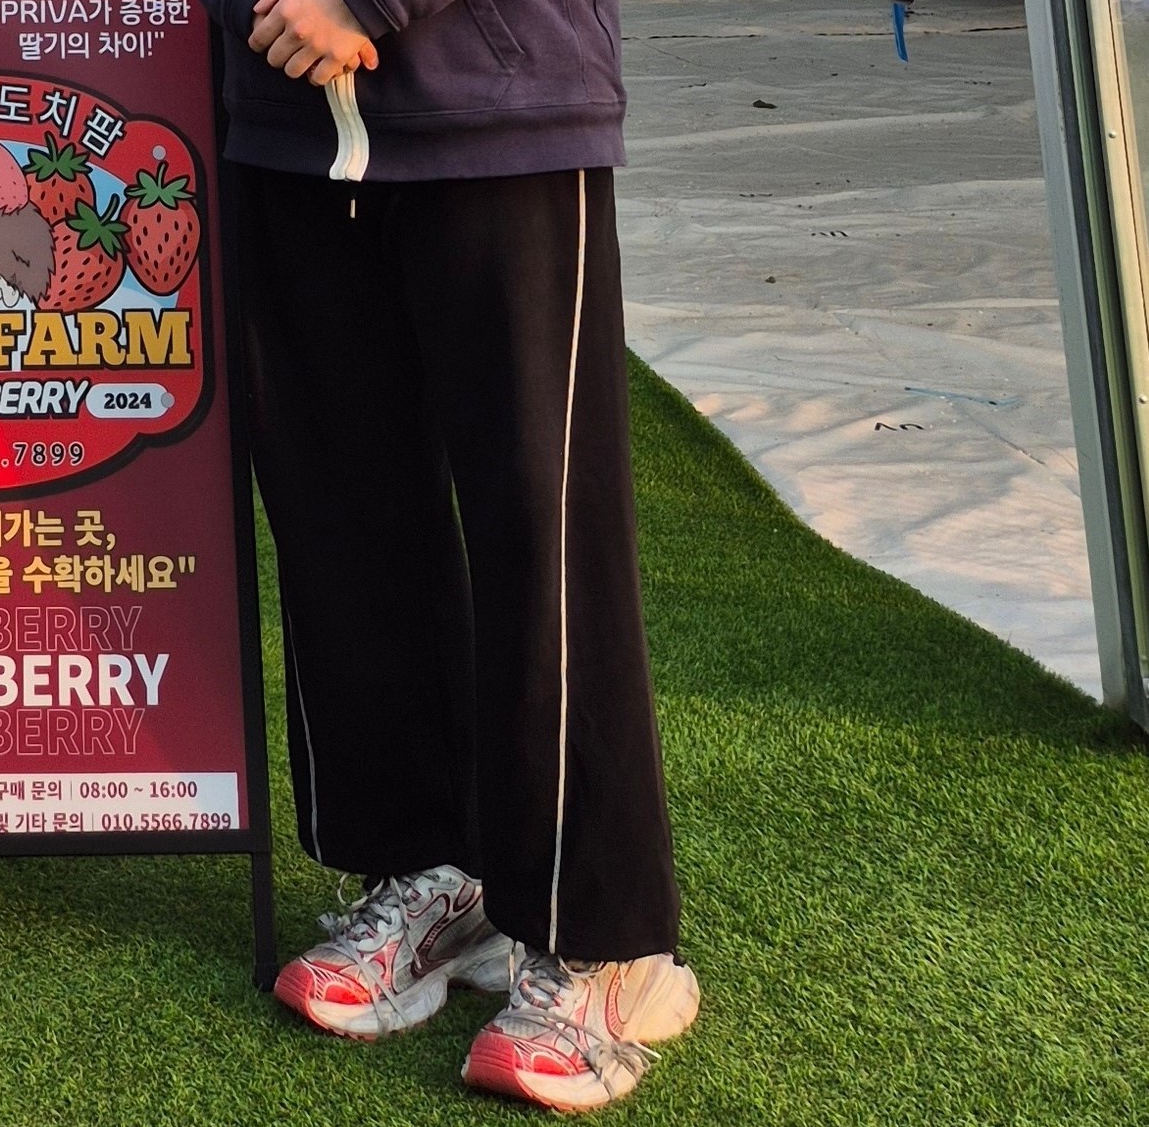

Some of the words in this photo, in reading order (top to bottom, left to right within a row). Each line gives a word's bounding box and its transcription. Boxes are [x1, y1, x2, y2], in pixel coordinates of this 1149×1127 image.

[19, 31, 90, 60] 딸기의
[98, 31, 165, 59] 차이!"
[103, 392, 152, 410] 2024
[73, 510, 116, 550] 곳,
[22, 554, 196, 594] 수확하세요"
[31, 780, 62, 801] 문의
[79, 781, 128, 799] 08:00
[150, 781, 197, 799] 16:00
[15, 812, 47, 833] 기타
[52, 812, 83, 833] 문의
[101, 812, 231, 831] 010.5566.7899
